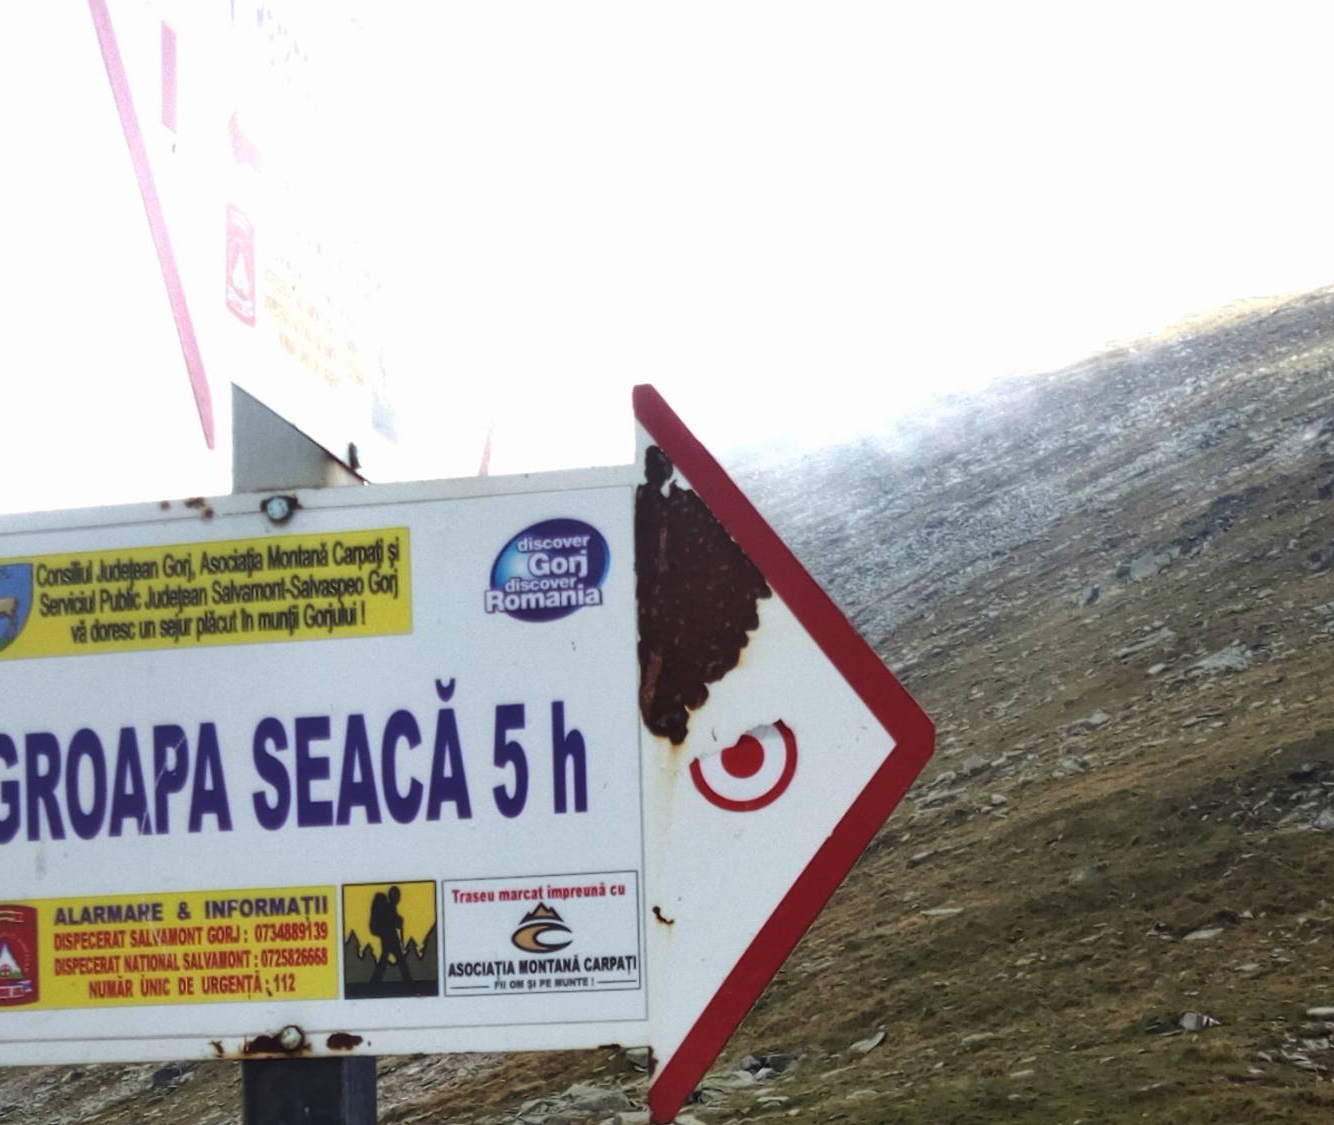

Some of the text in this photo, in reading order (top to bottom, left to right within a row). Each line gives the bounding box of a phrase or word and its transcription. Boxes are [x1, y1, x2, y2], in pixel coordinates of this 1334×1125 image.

[517, 536, 590, 551] discover
[36, 559, 92, 587] Consiliul
[267, 541, 328, 571] Montană
[529, 549, 587, 578] Gorj
[40, 590, 95, 618] Serviciul
[100, 586, 141, 613] Public
[212, 573, 364, 605] Salvamont-Salvaspeo
[369, 569, 398, 599] Gorj
[486, 584, 601, 612] Romania
[505, 577, 577, 592] discover
[91, 618, 135, 643] doresc
[139, 620, 155, 639] un
[160, 616, 193, 644] sejur
[196, 609, 237, 642] plăcut
[304, 601, 357, 633] Gorjului
[252, 678, 473, 831] SEACĂ
[492, 703, 529, 819] 5
[551, 700, 588, 815] h
[452, 888, 494, 903] Traseu
[499, 886, 543, 902] marcat
[610, 884, 625, 896] cu
[54, 903, 163, 926] ALARMARE
[177, 902, 191, 921] &
[54, 930, 125, 951] DISPECERAT
[130, 926, 203, 948] SALVAMONT
[207, 924, 240, 944] GORJ
[254, 921, 328, 943] 0734889139
[54, 955, 120, 976] DISPECERAT
[182, 949, 251, 971] SALVAMONT
[261, 947, 328, 968] 0725826668
[519, 955, 580, 974] MONTANĂ
[178, 976, 194, 996] DE
[273, 973, 295, 993] 112
[509, 980, 524, 989] OM
[539, 979, 552, 988] PE
[555, 977, 588, 987] MUNTE
